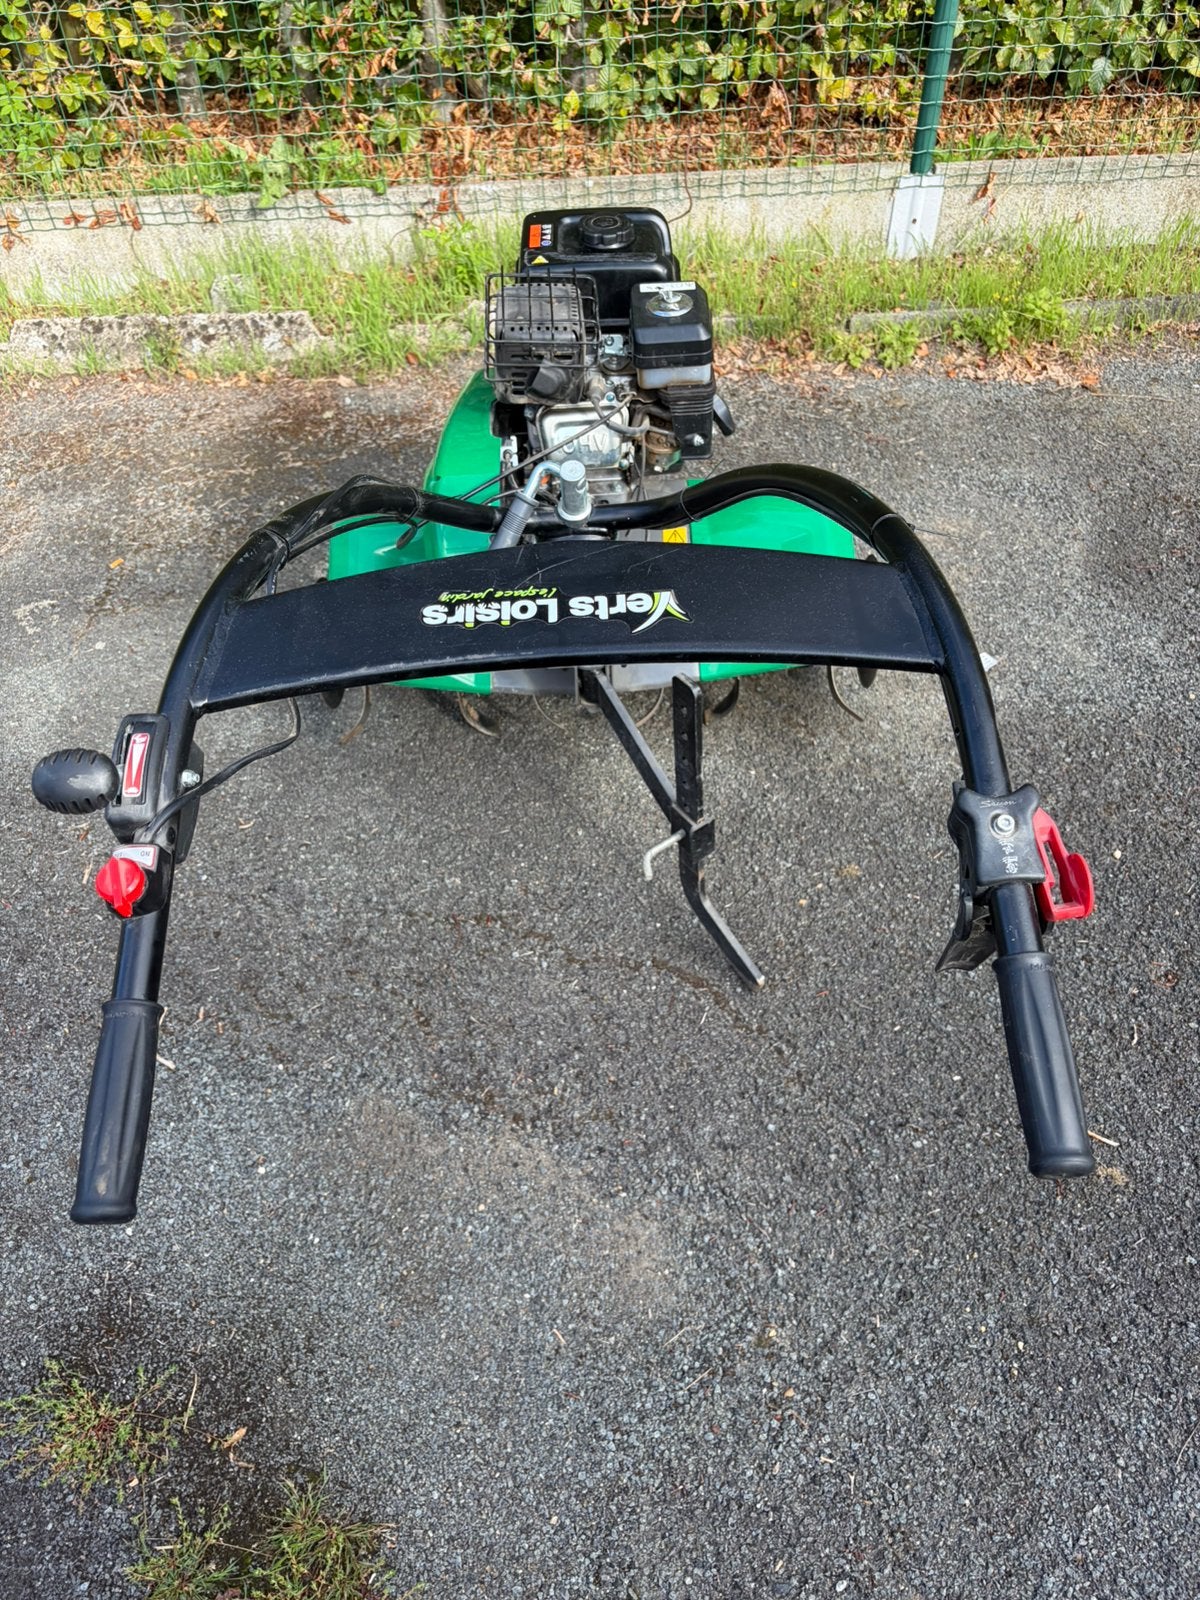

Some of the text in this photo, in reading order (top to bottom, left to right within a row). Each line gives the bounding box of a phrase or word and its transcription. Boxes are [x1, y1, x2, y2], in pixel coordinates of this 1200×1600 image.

[494, 585, 557, 598] l'espace
[423, 591, 690, 633] Verts Loisirs
